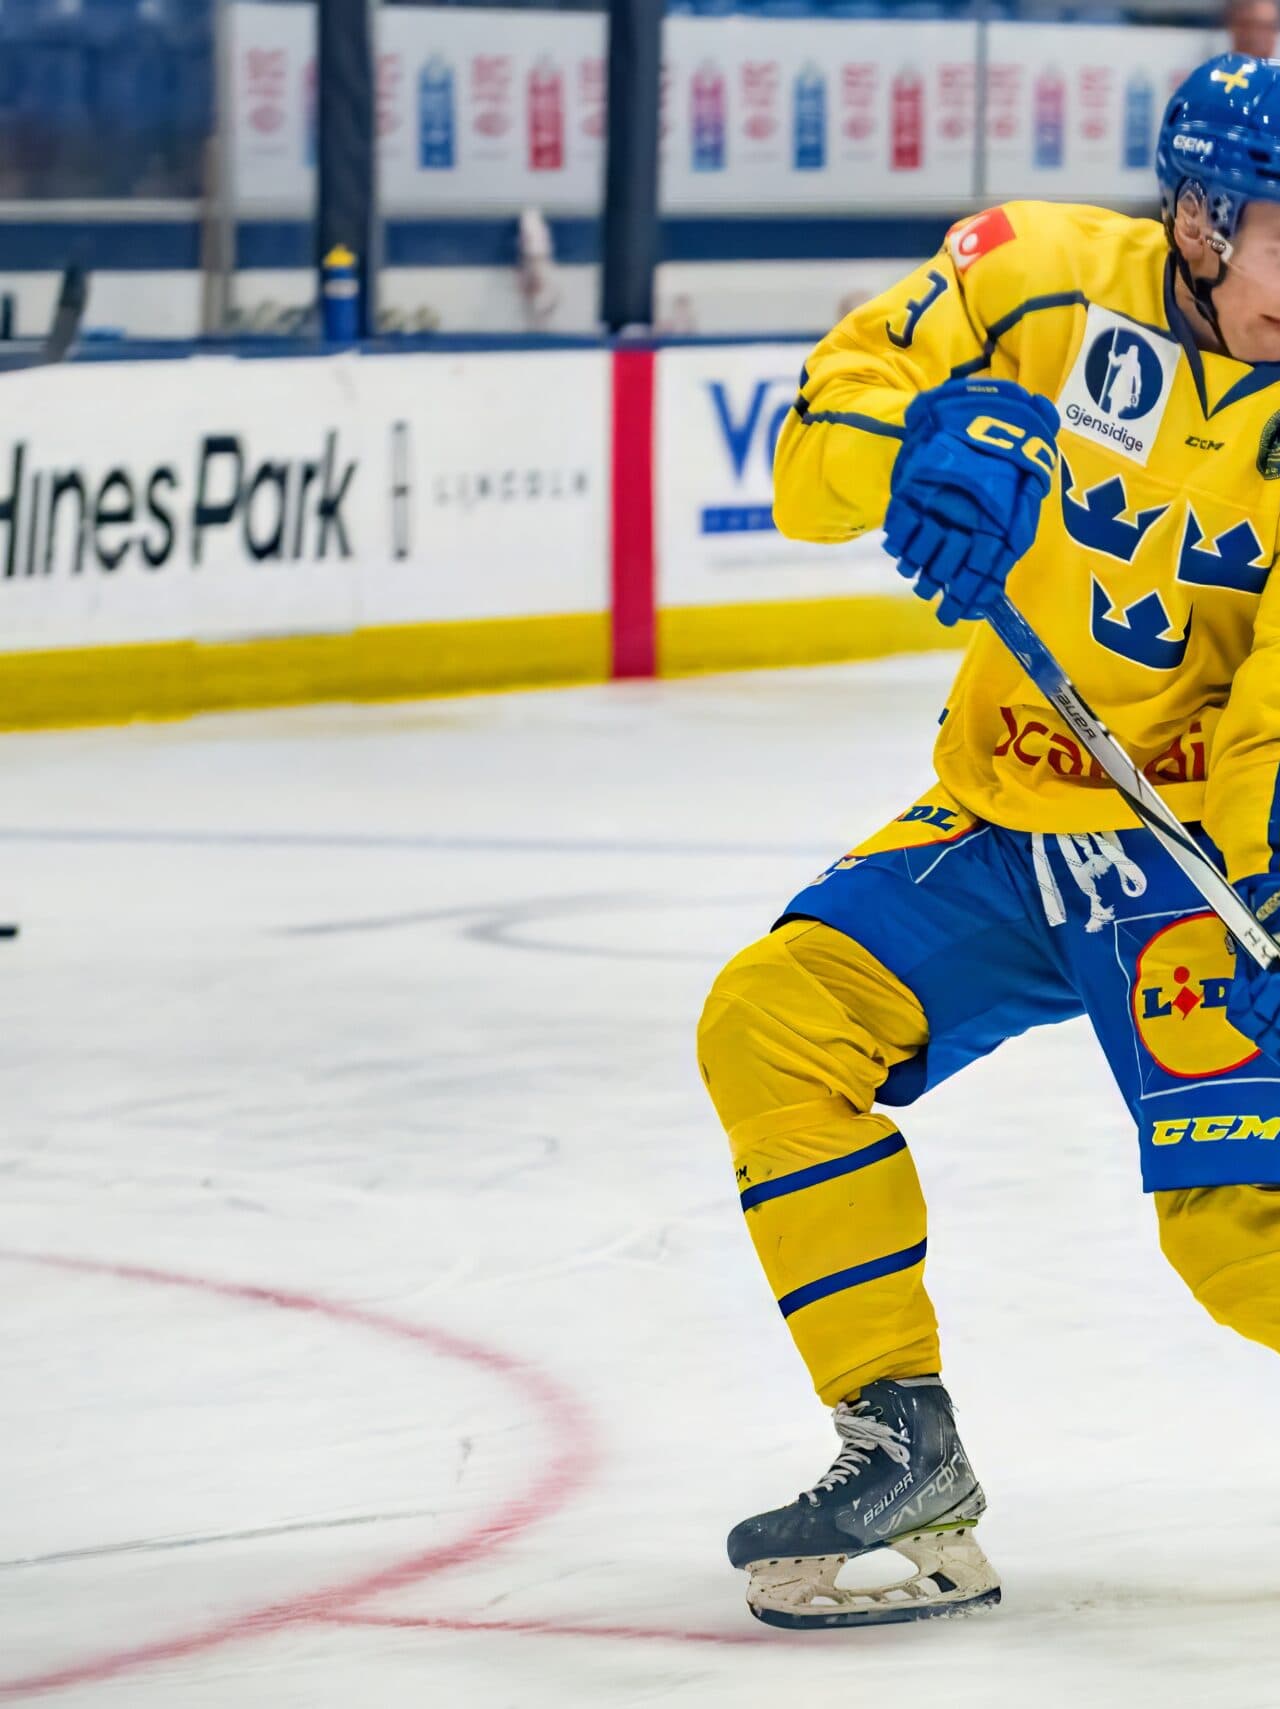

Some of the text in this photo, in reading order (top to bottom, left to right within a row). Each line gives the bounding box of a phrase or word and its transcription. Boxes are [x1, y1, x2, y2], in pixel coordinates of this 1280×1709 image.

[966, 415, 1057, 471] CC
[1066, 403, 1144, 452] Gjensidige
[1185, 436, 1225, 451] CCM
[193, 430, 358, 568] Park
[1056, 686, 1096, 740] AUER
[898, 805, 958, 832] DL
[863, 1471, 914, 1527] BAUER
